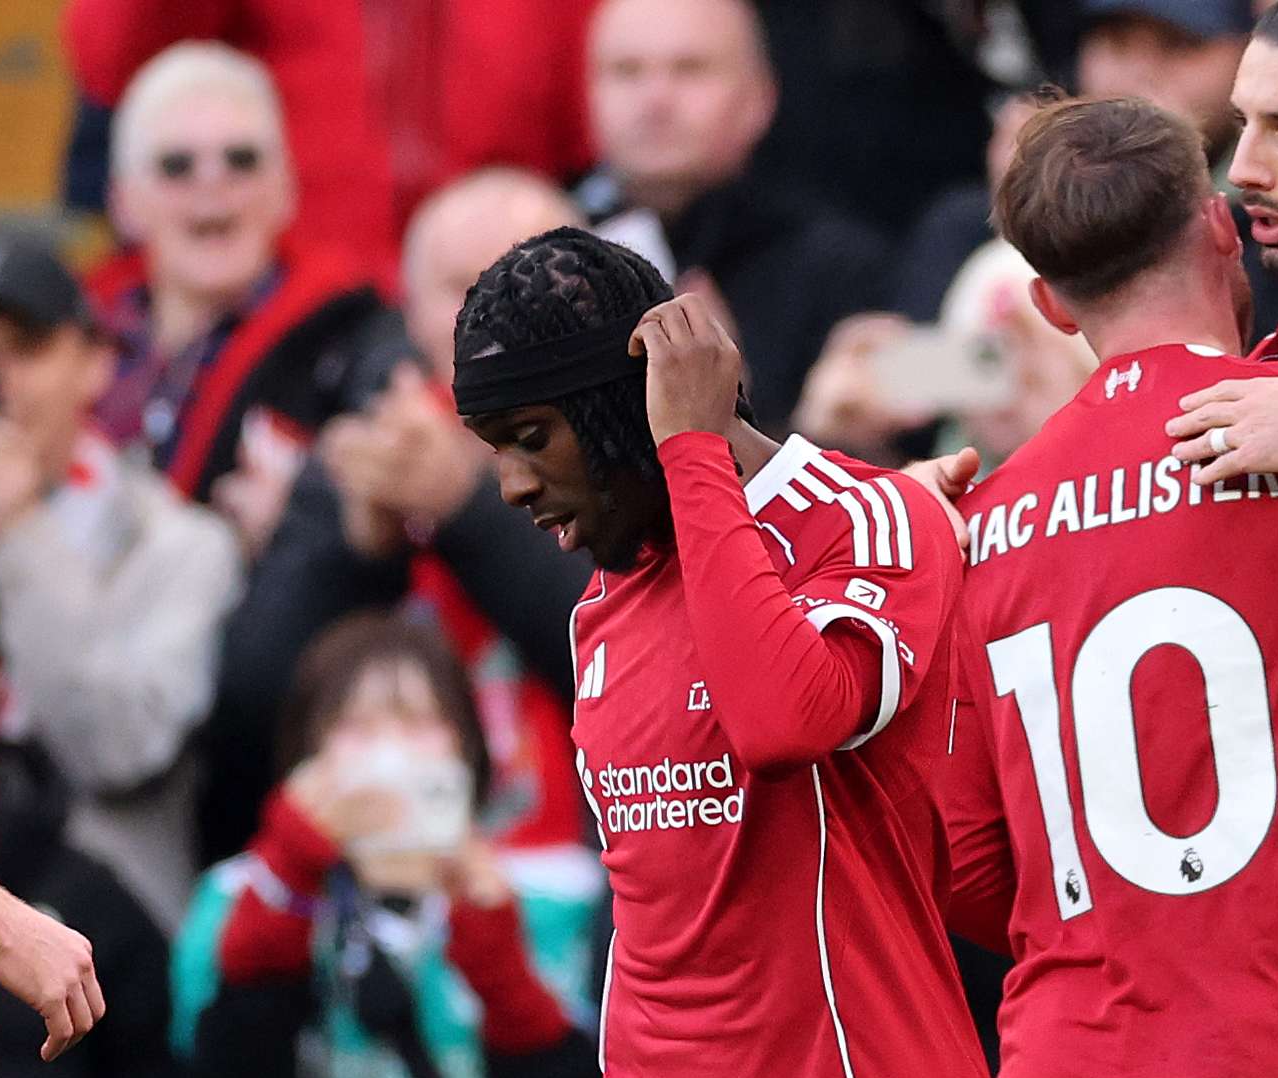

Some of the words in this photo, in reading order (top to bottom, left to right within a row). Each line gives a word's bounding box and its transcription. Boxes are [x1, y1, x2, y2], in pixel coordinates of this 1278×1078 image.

[598, 753, 733, 798] standard
[986, 586, 1278, 922] 10
[607, 787, 744, 833] chartered
